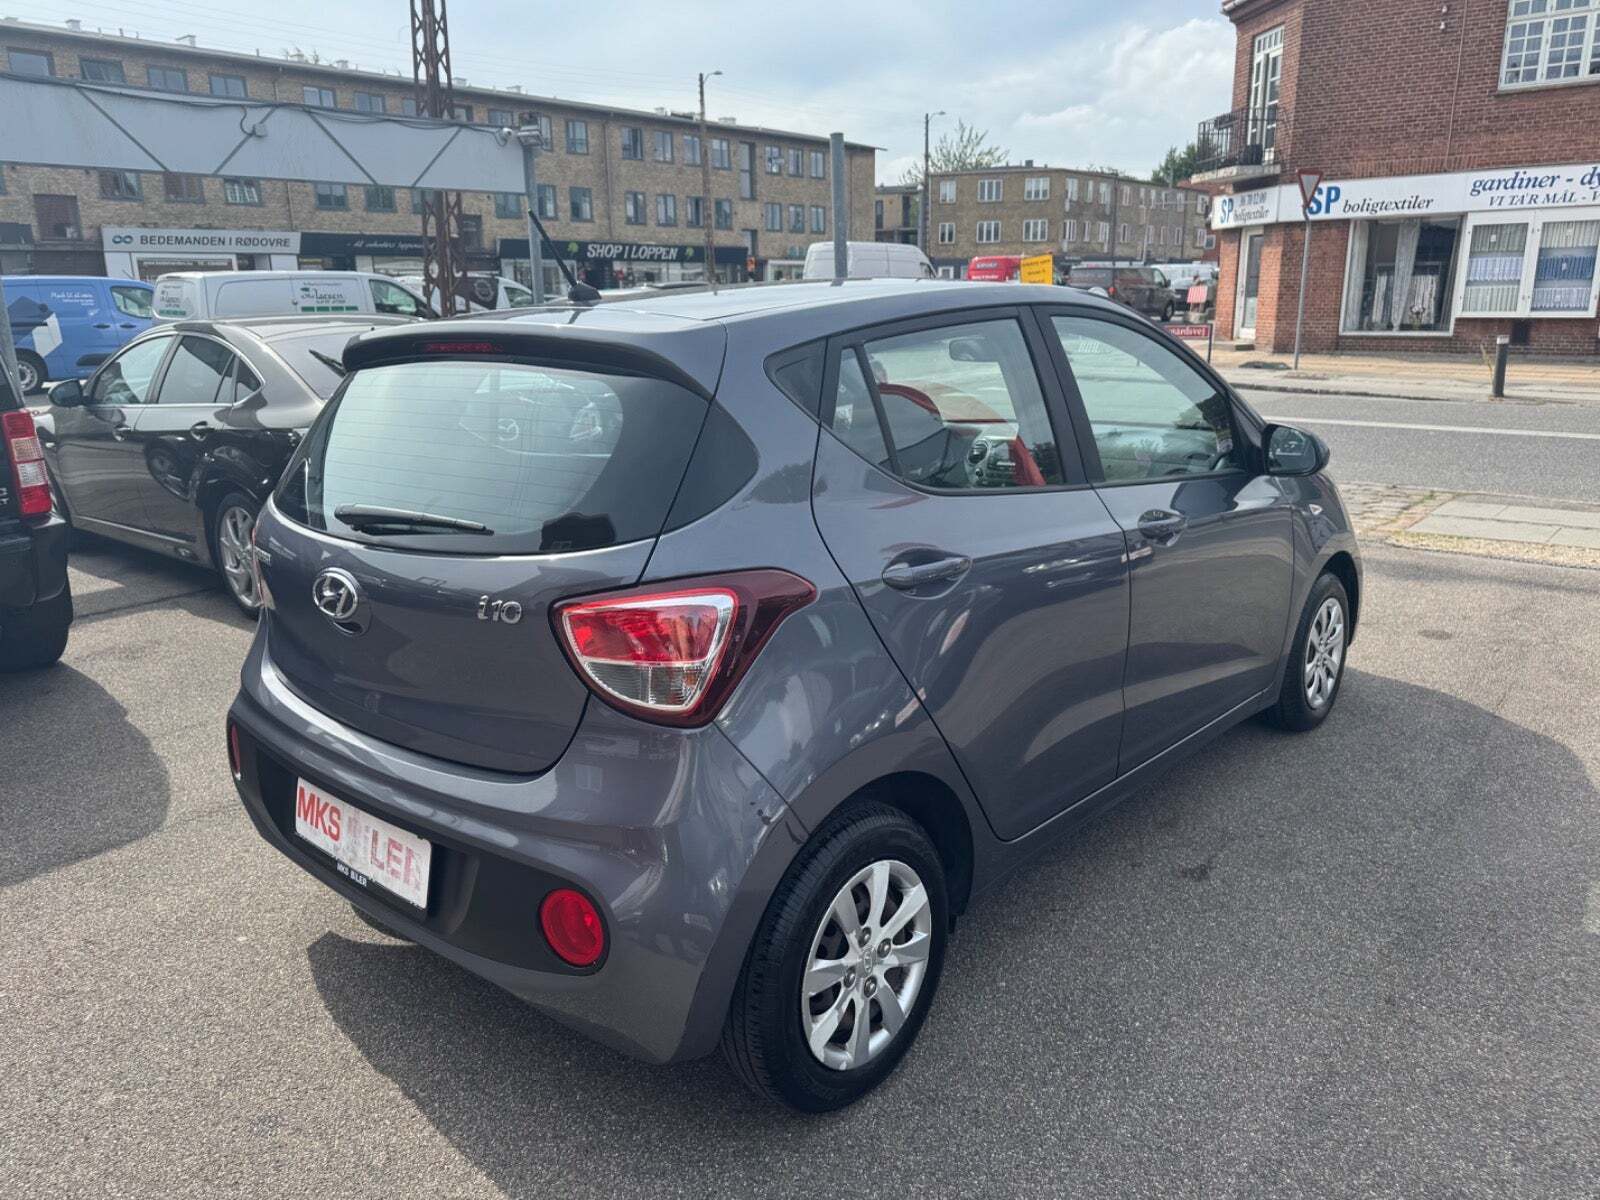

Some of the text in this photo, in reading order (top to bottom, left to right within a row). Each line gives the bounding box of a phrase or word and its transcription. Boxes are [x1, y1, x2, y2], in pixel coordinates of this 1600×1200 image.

[1470, 171, 1560, 196] gardiner
[1220, 198, 1234, 223] SP
[1307, 186, 1434, 215] SP boligtextiler
[1489, 195, 1505, 206] VI
[140, 234, 291, 248] BEDEMANDEN I RØDOVRE
[586, 243, 678, 260] SHOP I LOPPEN
[476, 594, 523, 625] i10
[297, 785, 341, 843] MKS
